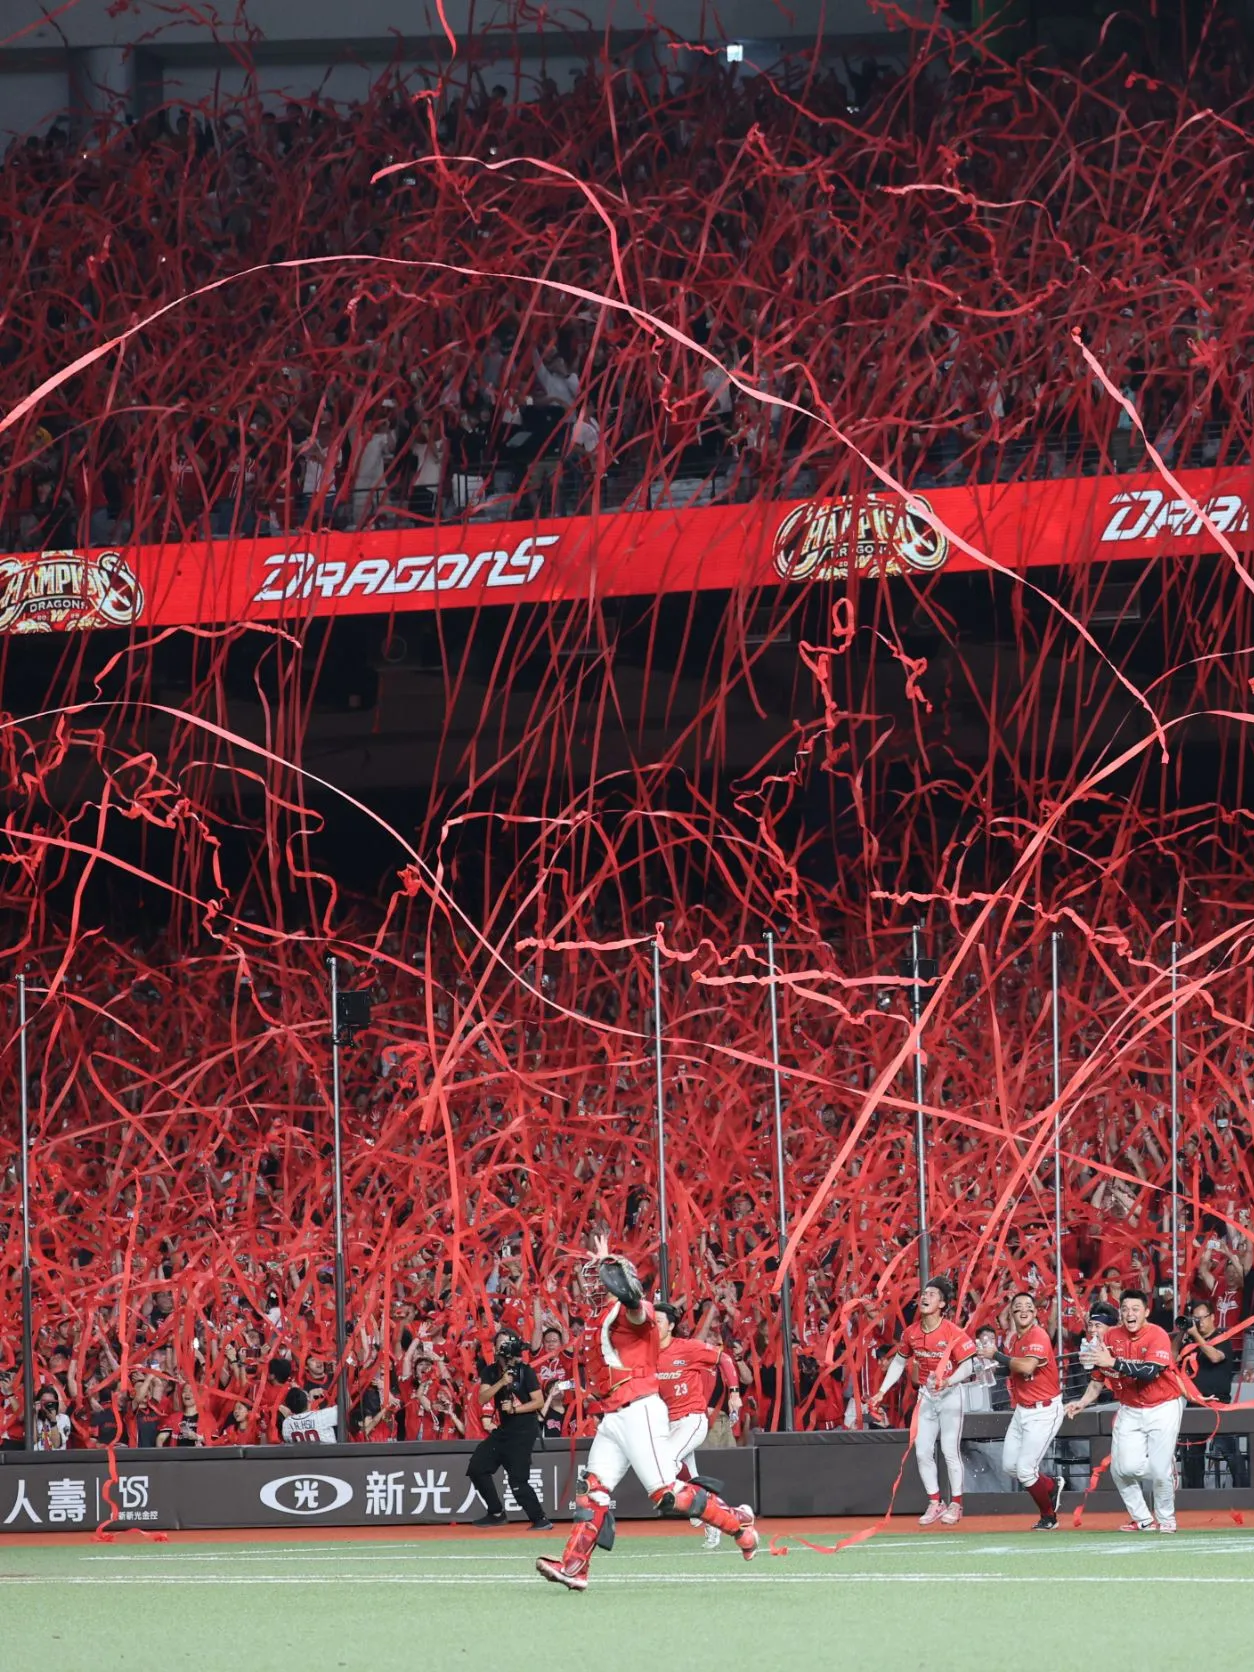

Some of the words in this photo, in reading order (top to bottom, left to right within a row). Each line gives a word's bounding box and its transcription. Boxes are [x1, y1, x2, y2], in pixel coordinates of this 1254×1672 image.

[252, 535, 560, 602] DRAGONS
[673, 1383, 688, 1397] 23
[3, 1478, 86, 1524] 人壽
[294, 1480, 319, 1509] 光
